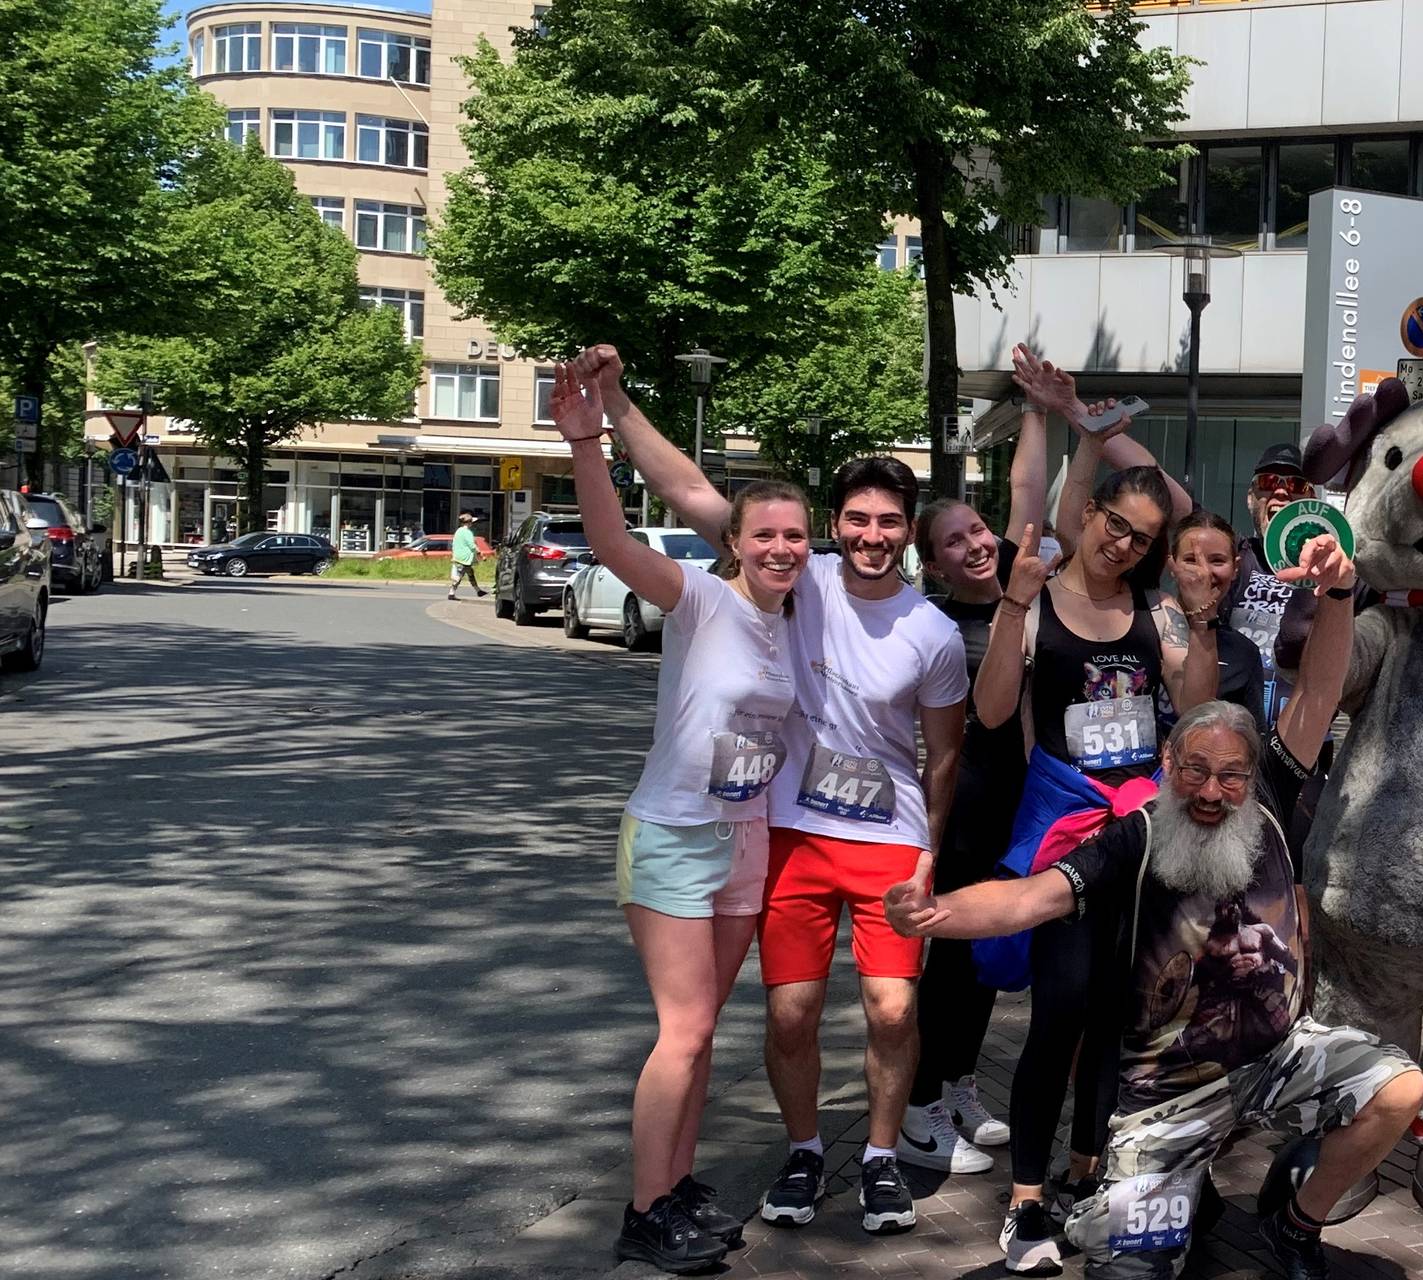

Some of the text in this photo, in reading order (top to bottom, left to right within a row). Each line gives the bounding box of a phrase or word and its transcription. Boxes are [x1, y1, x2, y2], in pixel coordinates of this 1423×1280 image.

[1339, 198, 1363, 247] 6-8
[1400, 363, 1413, 374] Mo
[20, 399, 33, 417] P
[1412, 390, 1423, 400] Sa
[1298, 500, 1330, 516] AUF
[1092, 654, 1141, 664] LOVE ALL
[1082, 719, 1140, 756] 531
[727, 752, 777, 787] 448
[816, 771, 882, 808] 447
[1127, 1195, 1190, 1235] 529
